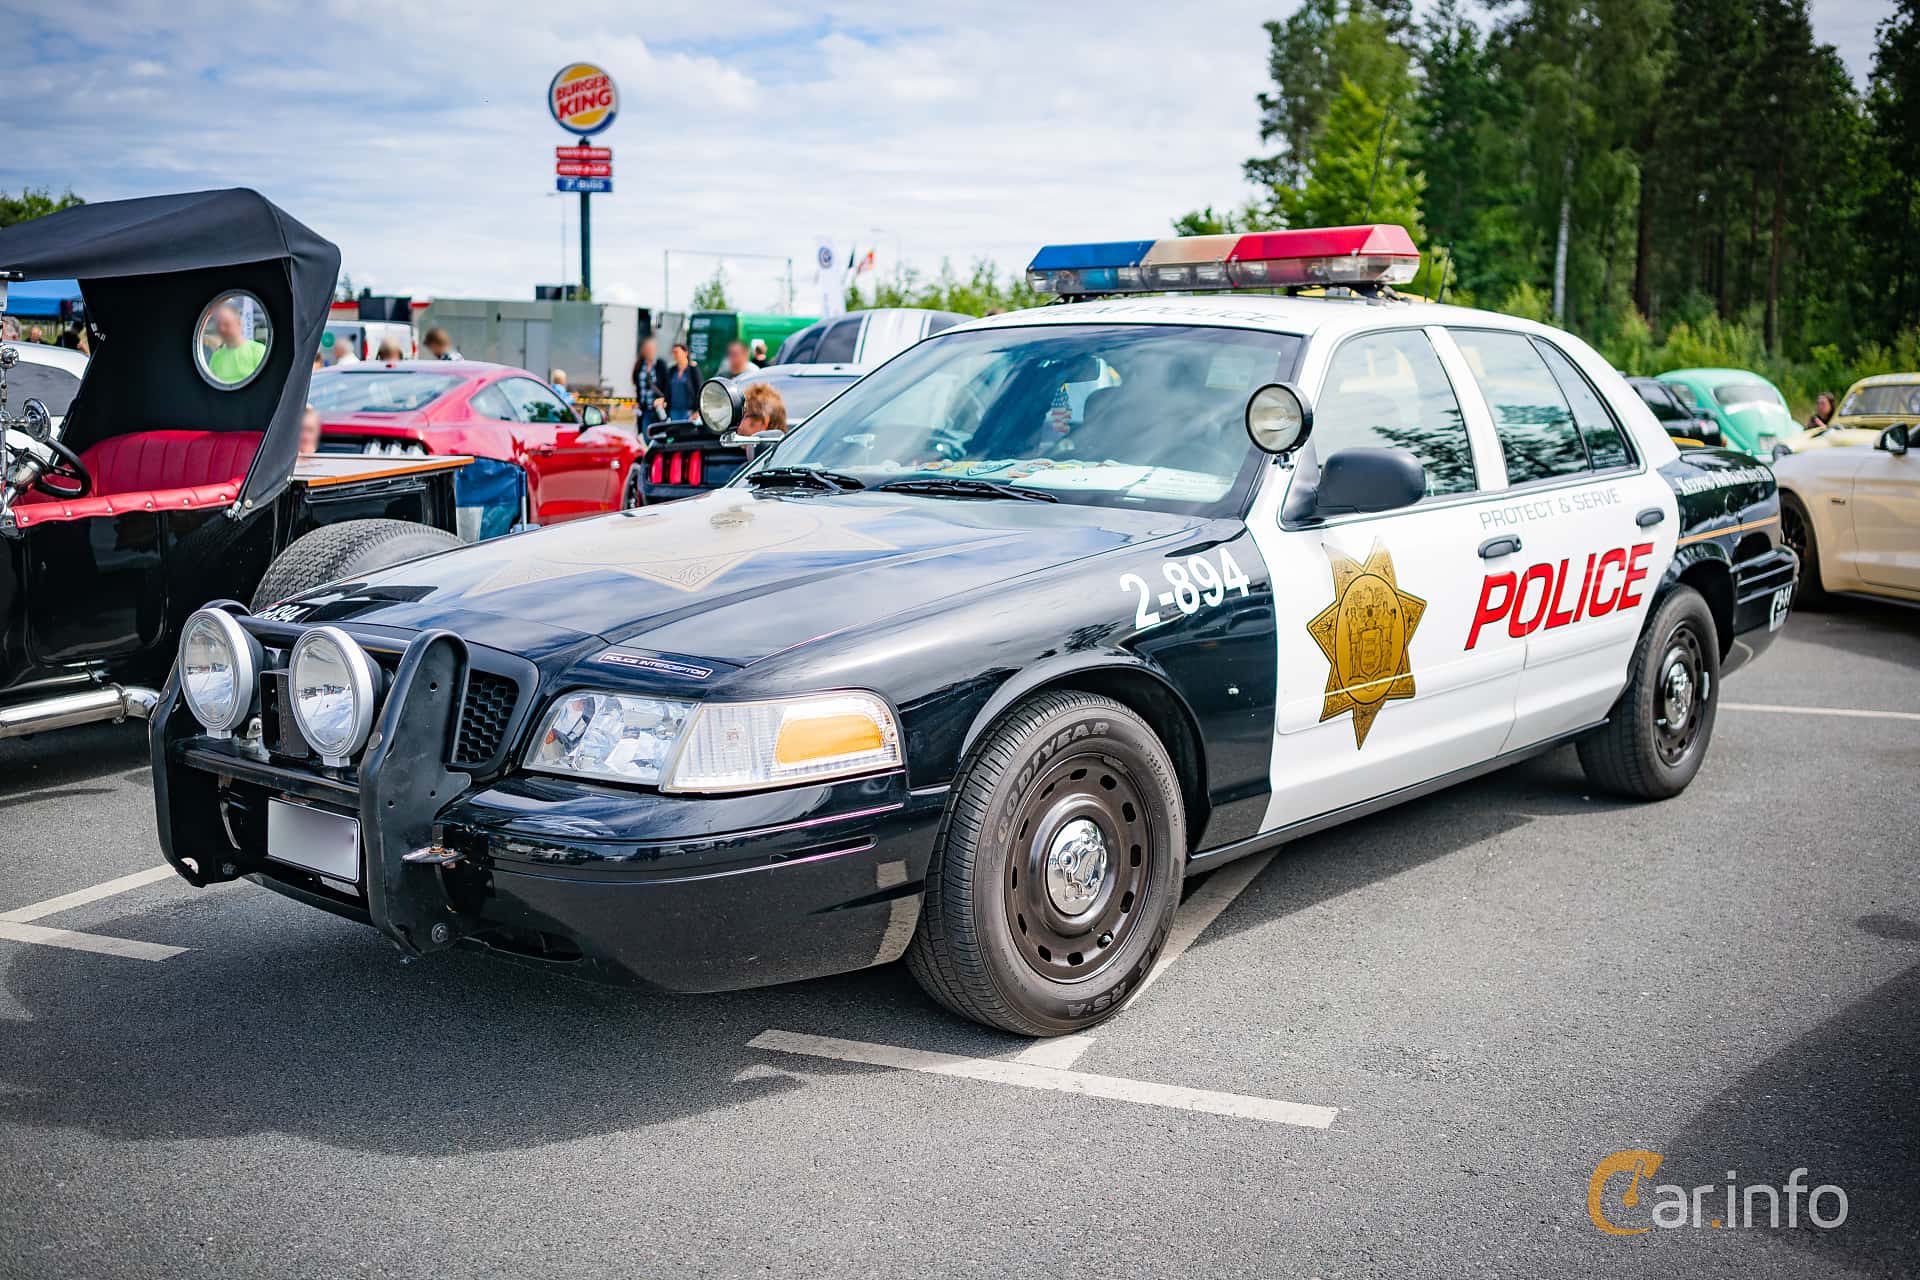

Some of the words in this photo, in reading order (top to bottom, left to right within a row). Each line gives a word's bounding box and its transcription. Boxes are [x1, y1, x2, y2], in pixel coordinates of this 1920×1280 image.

[555, 75, 610, 100] BURGER
[558, 89, 612, 121] KING
[1480, 500, 1554, 530] PROTECT
[1558, 497, 1571, 513] &
[1573, 488, 1623, 511] SERVE
[1119, 547, 1251, 630] 2-894
[1463, 542, 1654, 651] POLICE
[604, 655, 638, 664] POLICE
[639, 660, 707, 677] INTERCEPTOR
